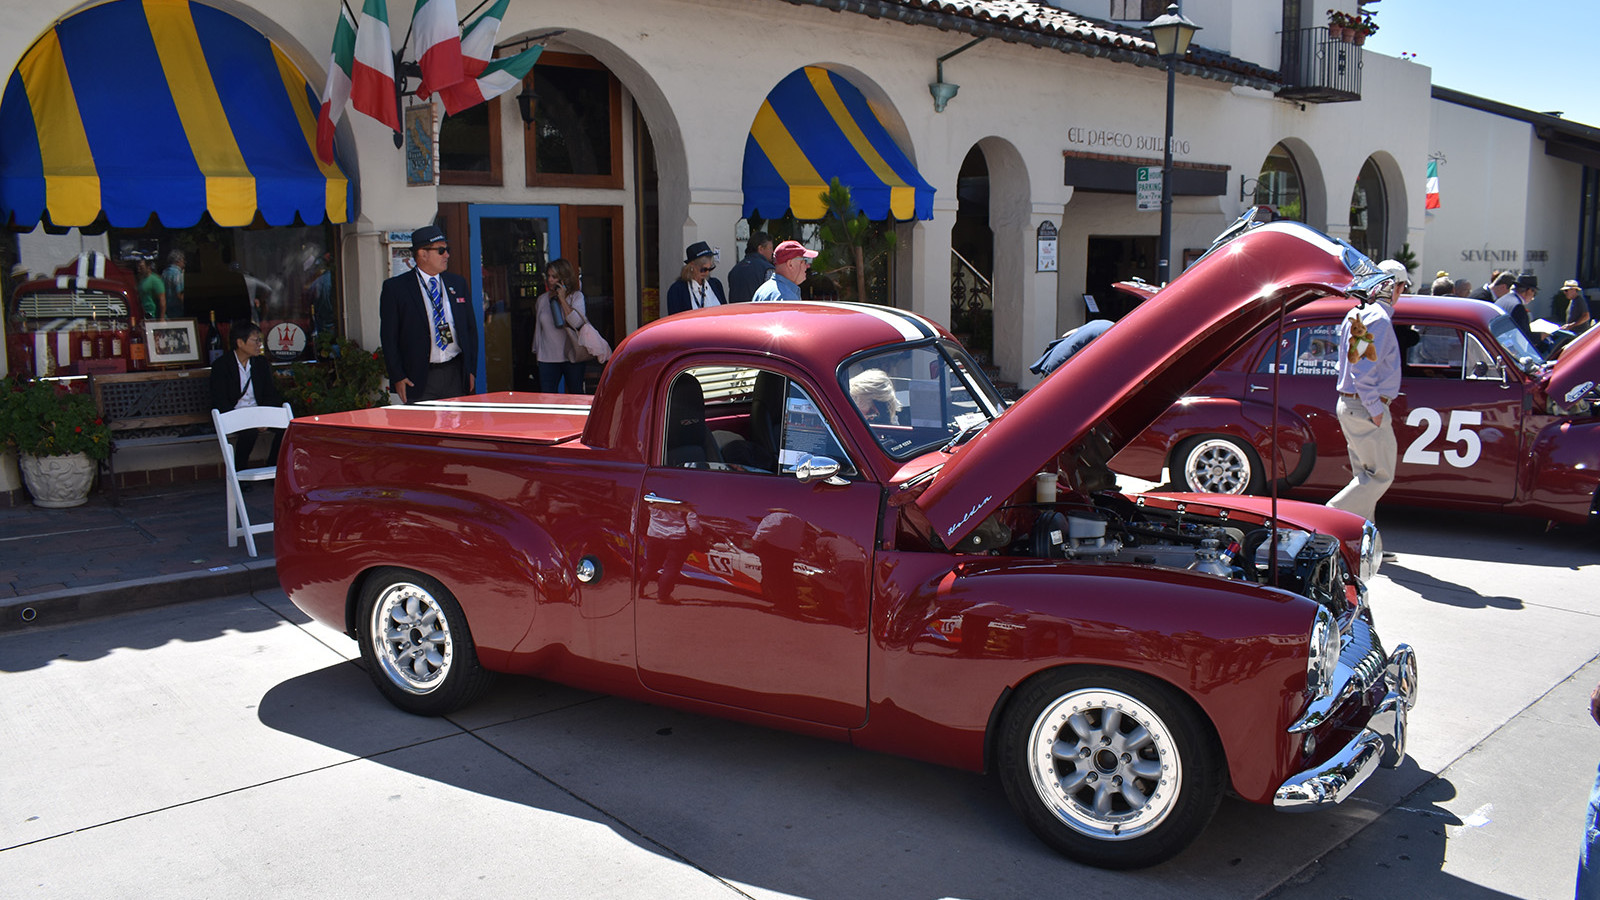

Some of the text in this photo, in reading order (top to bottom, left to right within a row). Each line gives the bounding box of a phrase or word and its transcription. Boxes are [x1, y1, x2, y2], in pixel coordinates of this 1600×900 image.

[1068, 127, 1085, 143] EL
[1136, 136, 1191, 154] BUILING
[1140, 169, 1147, 180] 2
[1138, 182, 1162, 192] PARKING
[1461, 249, 1518, 262] SEVENTH
[1297, 367, 1321, 375] Chris
[1402, 407, 1482, 468] 25
[947, 495, 993, 537] Holden
